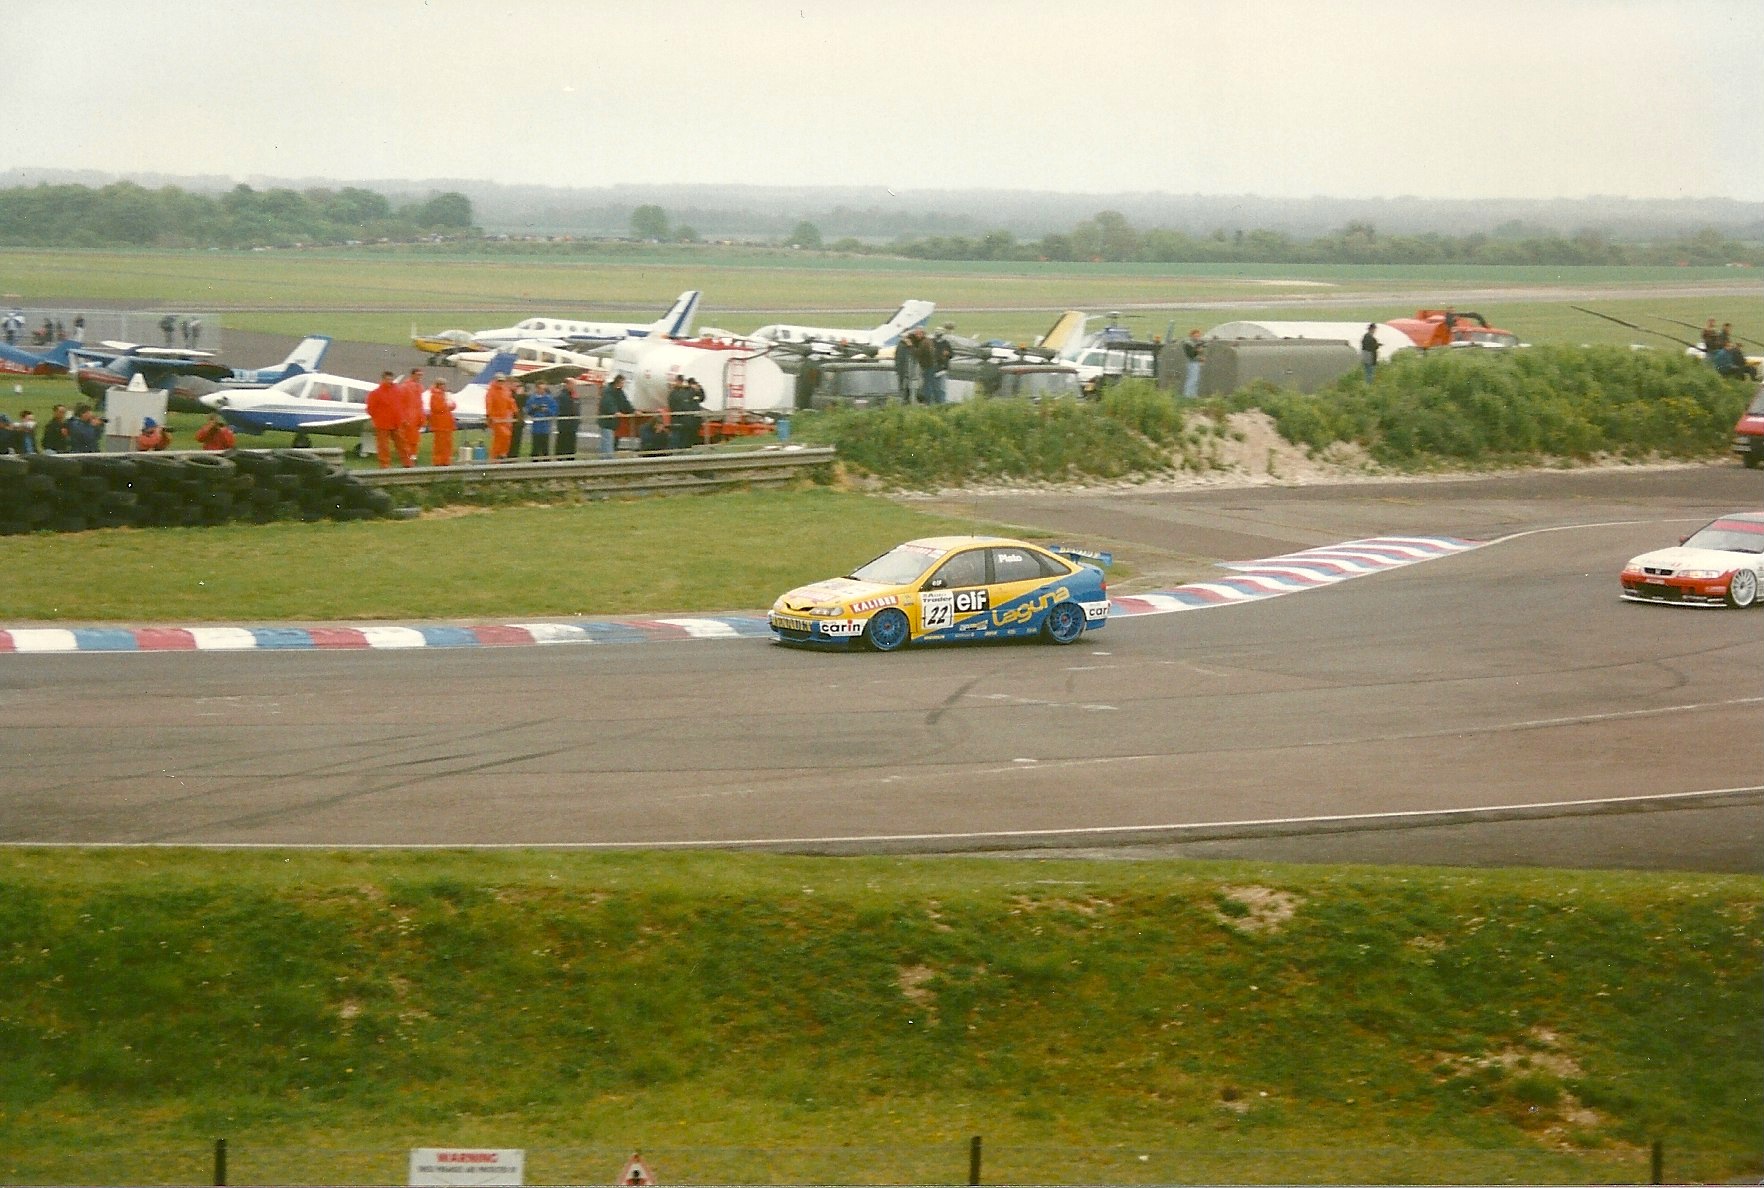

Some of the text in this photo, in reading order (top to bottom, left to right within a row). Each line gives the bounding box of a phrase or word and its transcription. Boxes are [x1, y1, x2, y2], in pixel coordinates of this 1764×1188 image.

[852, 596, 897, 613] KALIBER
[957, 591, 986, 611] elf
[927, 606, 948, 625] 22
[821, 620, 861, 632] carin
